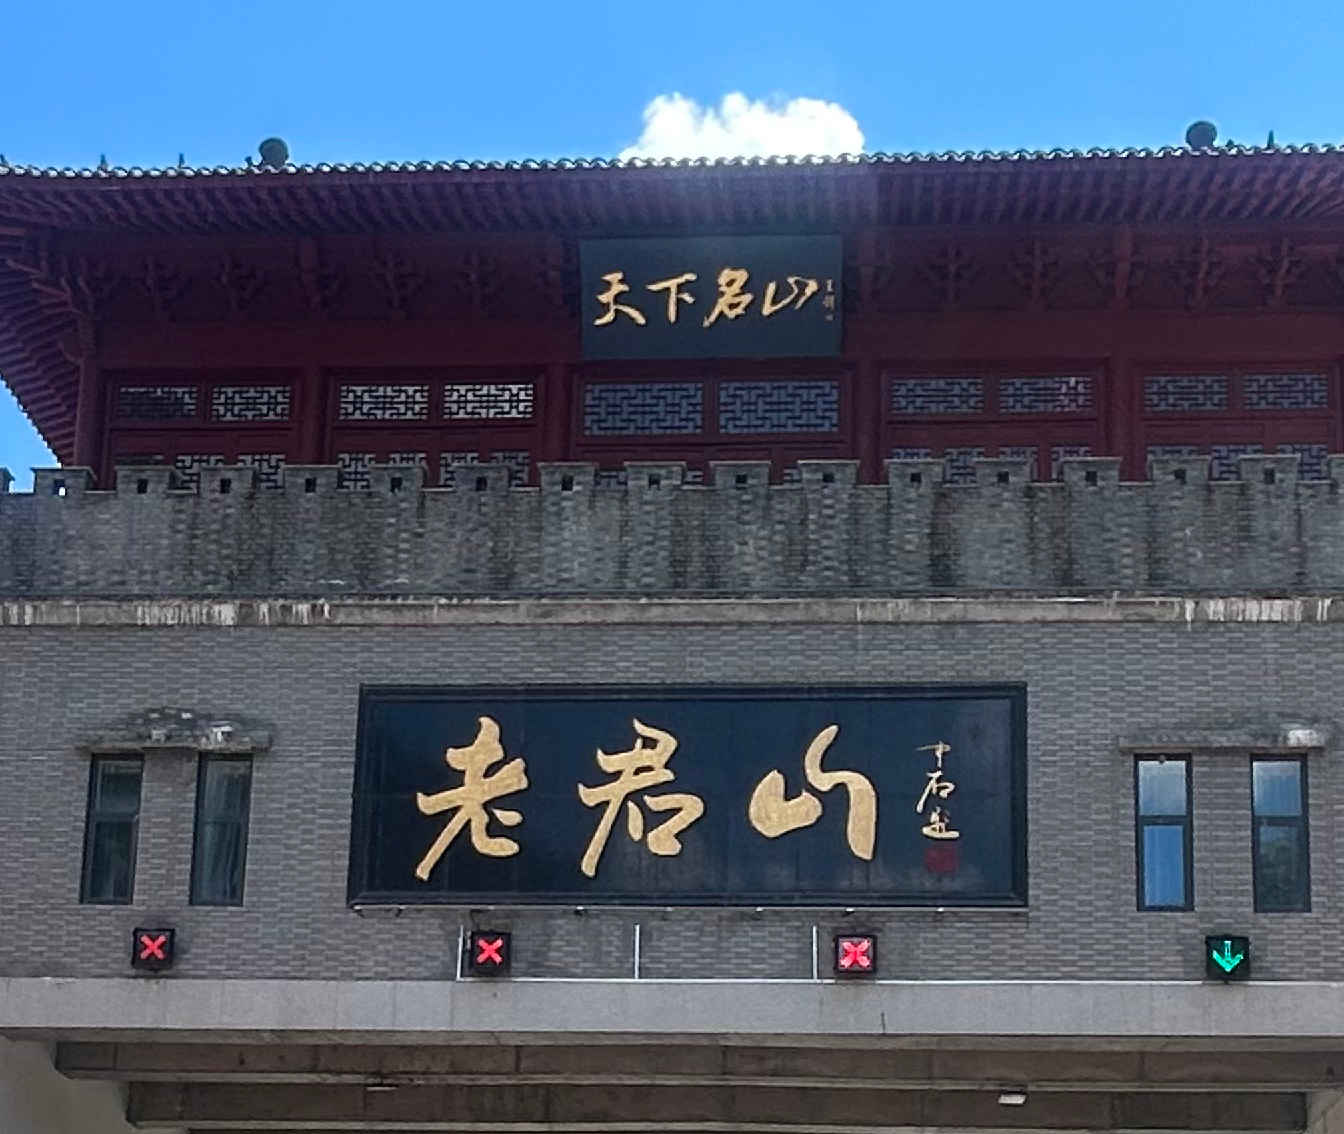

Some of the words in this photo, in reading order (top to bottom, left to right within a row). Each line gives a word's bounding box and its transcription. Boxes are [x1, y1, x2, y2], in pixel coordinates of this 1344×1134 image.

[593, 267, 819, 328] 天下名山
[416, 716, 877, 881] 老君山
